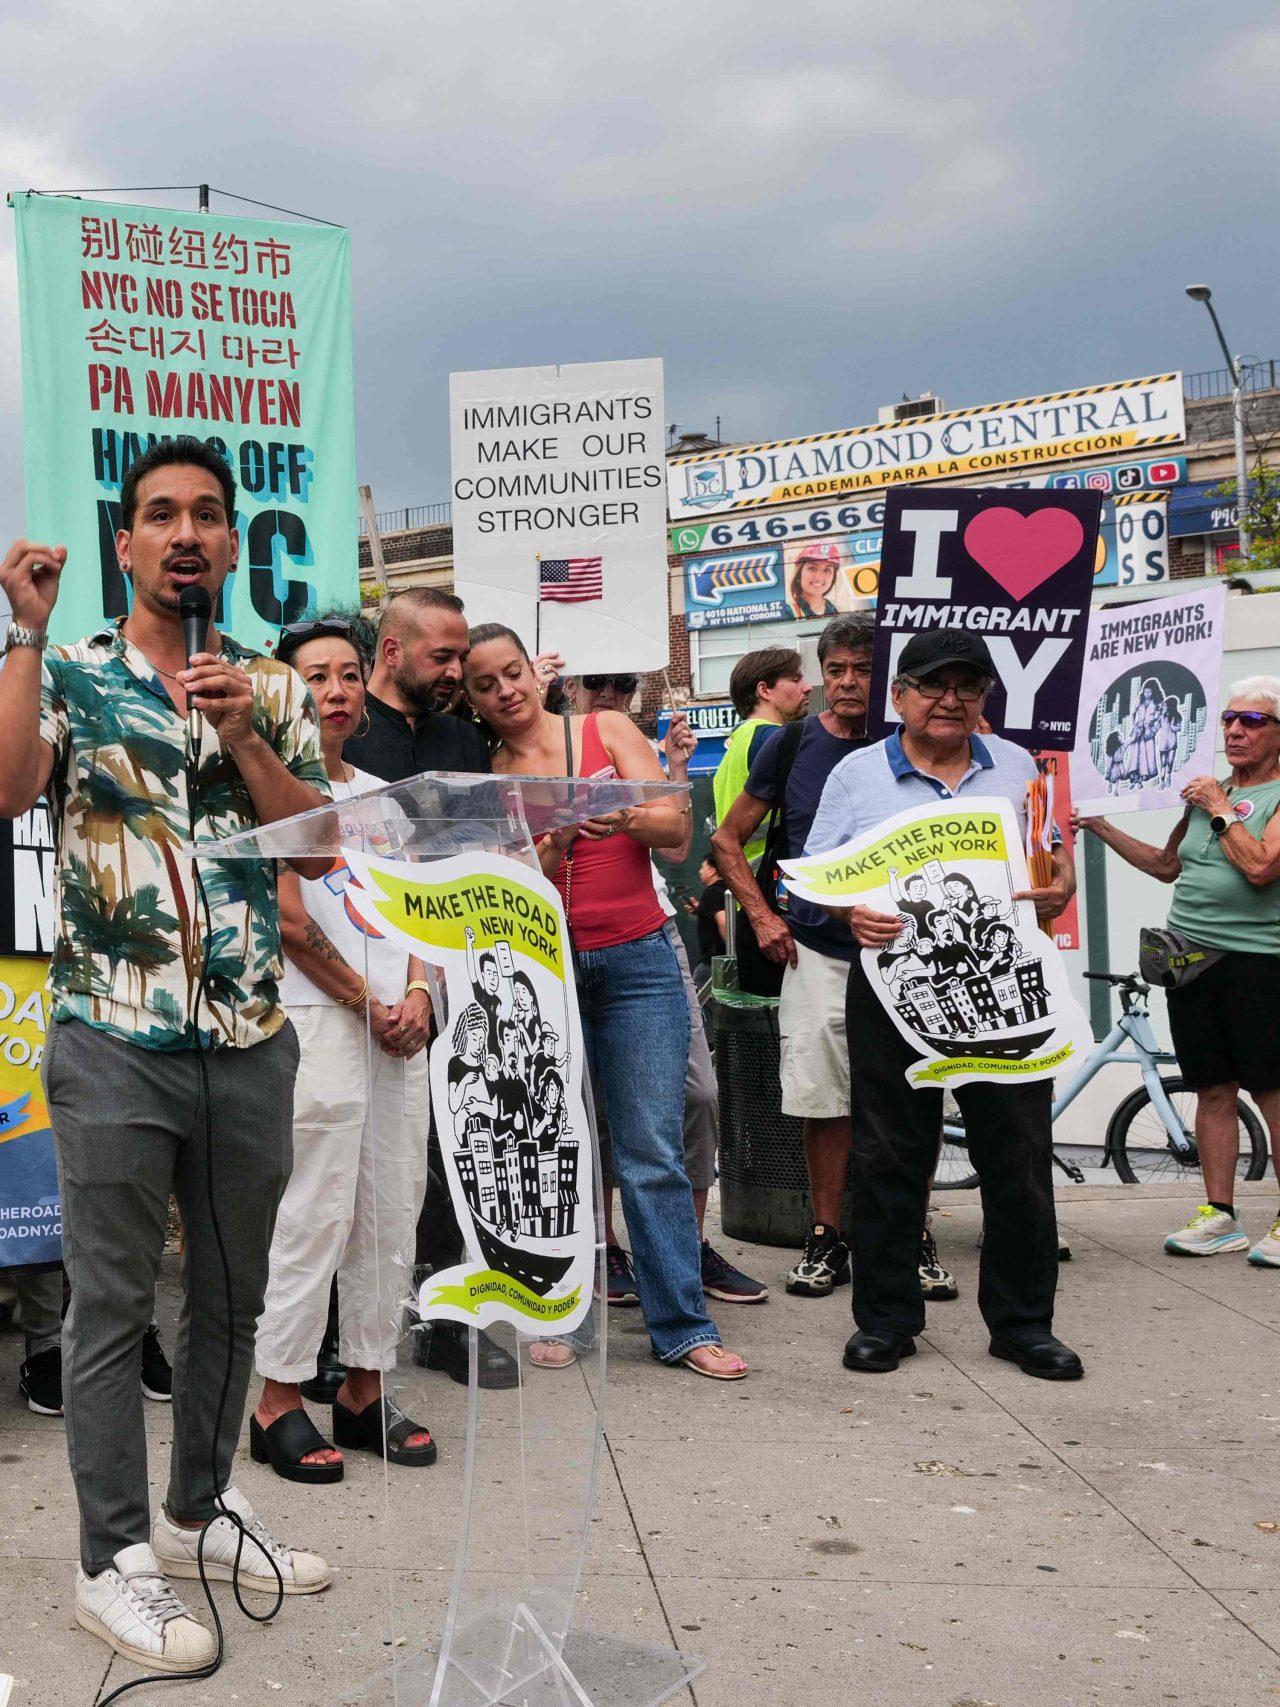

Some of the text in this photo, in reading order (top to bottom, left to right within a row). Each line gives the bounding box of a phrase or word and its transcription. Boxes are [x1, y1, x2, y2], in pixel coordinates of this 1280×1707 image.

[81, 216, 291, 279] 别碰纽约市
[81, 270, 297, 329] NYC NO SE TOCA
[85, 319, 301, 369] 손대지 마라
[88, 364, 301, 427] PA MANYEN
[464, 396, 652, 430] IMMIGRANTS
[478, 432, 646, 463] MAKE OUR
[737, 391, 1167, 490] DIAMOND CENTRAL
[240, 440, 308, 495] OFF
[454, 465, 661, 500] COMMUNITIES
[781, 434, 1123, 498] ACADEMIA PARA LA CONSTRUCCIÓN
[477, 502, 639, 533] STRONGER
[894, 509, 959, 599] I
[705, 608, 726, 619] 4010
[727, 603, 769, 616] NATIONAL
[710, 618, 721, 626] NY
[749, 610, 782, 621] CORONA
[880, 603, 1081, 633] IMMIGRANT
[1099, 603, 1205, 641] IMMIGRANTS
[1089, 620, 1214, 661] ARE NEW YORK!
[884, 632, 1074, 730] Y
[1049, 720, 1072, 732] NYIC
[825, 820, 997, 885] MAKE THE ROAD
[904, 839, 998, 867] NEW YORK
[404, 885, 557, 937] MAKE THE ROAD
[479, 916, 559, 964] NEW YORK
[933, 1062, 976, 1075] DIGNIDAD,
[978, 1062, 1030, 1071] COMUNIDAD
[1039, 1050, 1068, 1067] PODER
[469, 1281, 575, 1315] DIGNIDAD, COMUNIDAD Y PODER
